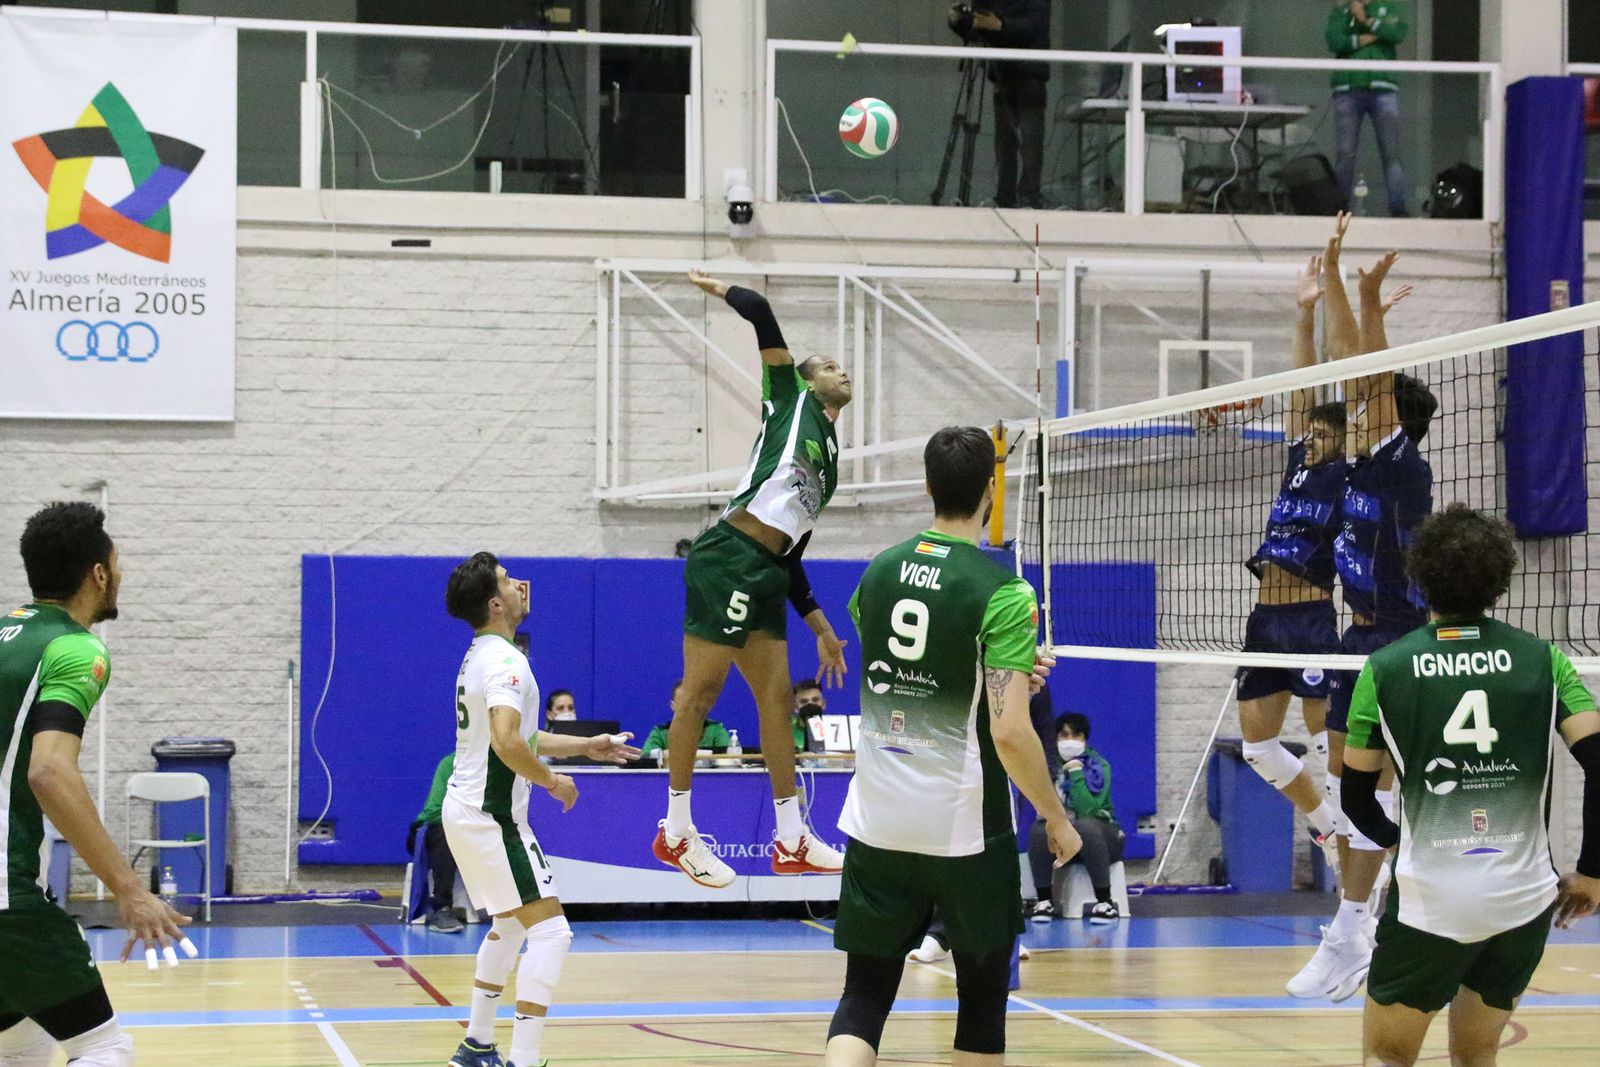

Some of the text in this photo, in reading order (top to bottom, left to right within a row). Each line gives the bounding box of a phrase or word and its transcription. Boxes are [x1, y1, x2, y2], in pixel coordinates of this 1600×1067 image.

[9, 270, 207, 288] XV Juegos Mediterráneos
[8, 288, 207, 316] Almería 2005
[899, 560, 942, 590] VIGIL
[726, 590, 750, 622] 5
[888, 598, 930, 661] 9
[1412, 649, 1512, 678] IGNACIO
[457, 685, 469, 730] 5
[1443, 689, 1500, 753] 4
[830, 723, 840, 743] 7
[708, 841, 774, 858] PUTACIÓ
